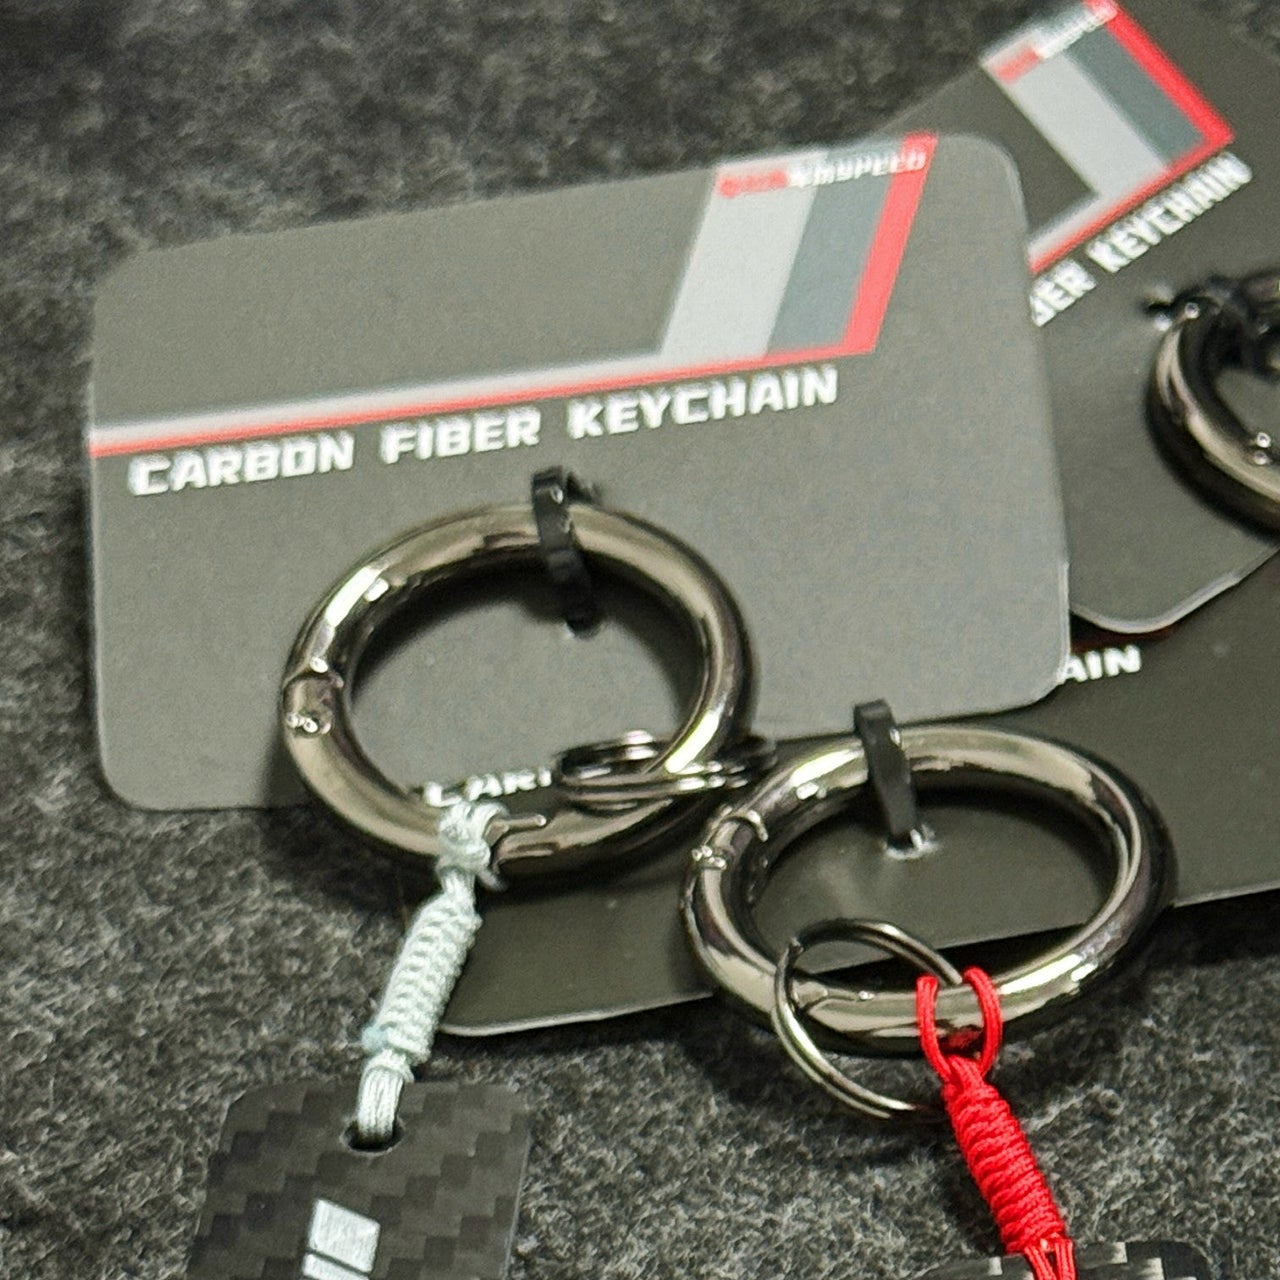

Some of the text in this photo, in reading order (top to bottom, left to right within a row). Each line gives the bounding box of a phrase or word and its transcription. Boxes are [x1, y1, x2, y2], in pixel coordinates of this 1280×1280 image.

[1086, 150, 1252, 273] KEYCHAIN
[128, 366, 838, 496] CARBON FIBER KEYCHAIN
[424, 767, 552, 808] CAR
